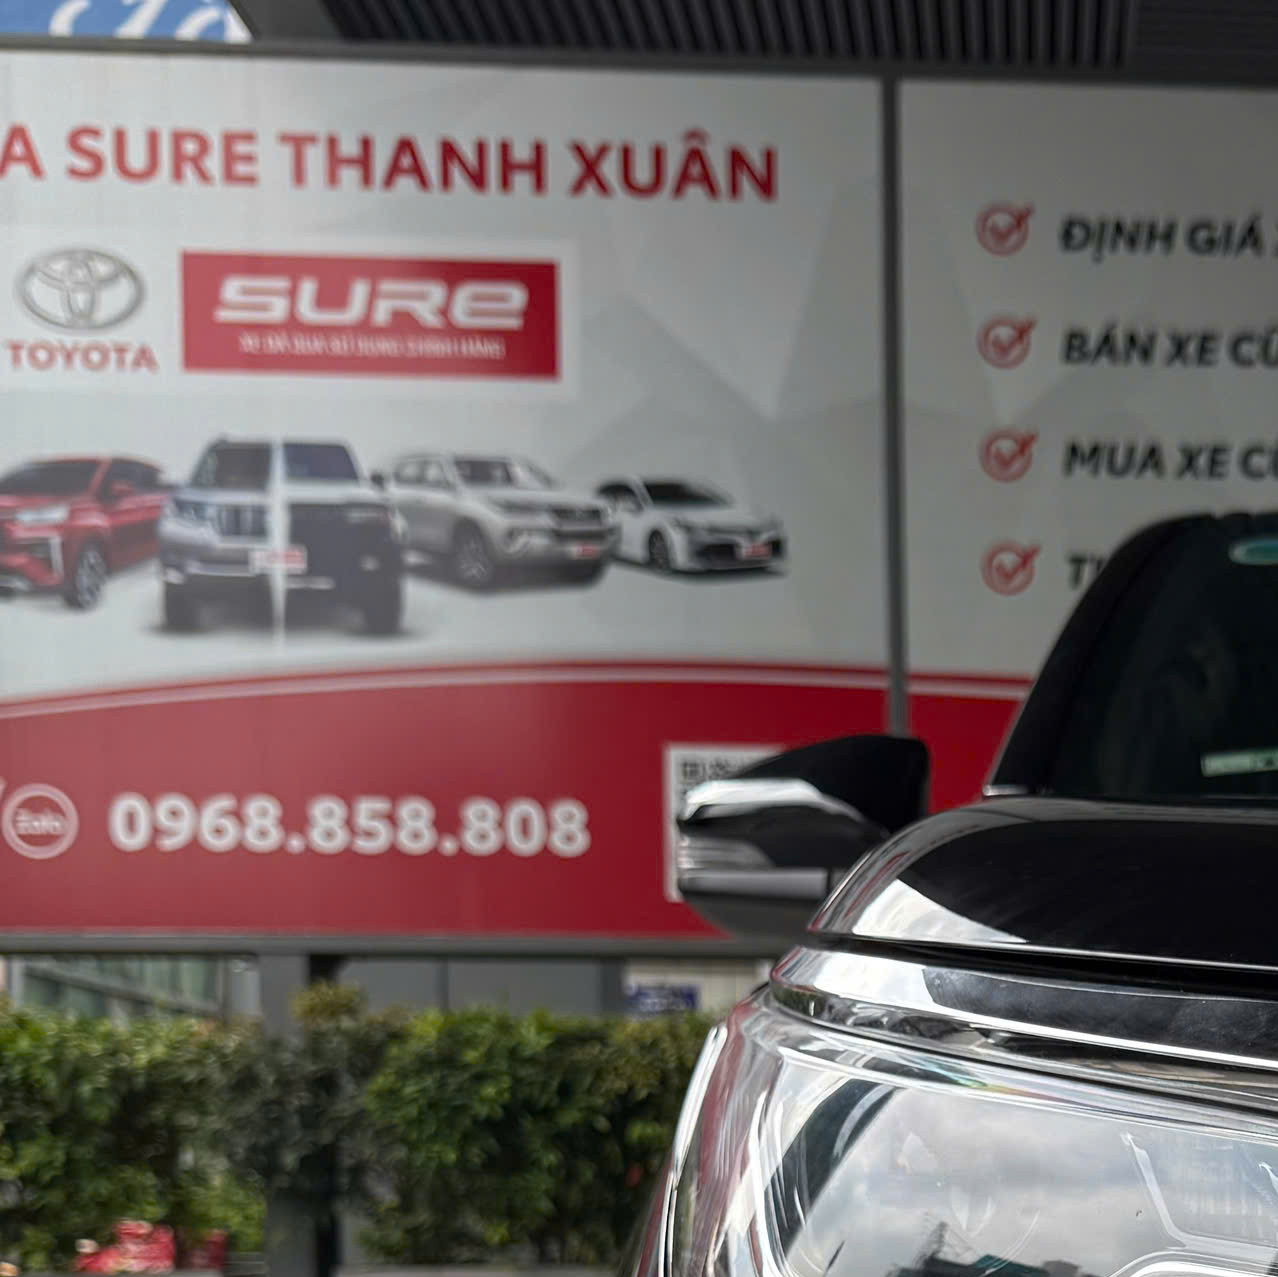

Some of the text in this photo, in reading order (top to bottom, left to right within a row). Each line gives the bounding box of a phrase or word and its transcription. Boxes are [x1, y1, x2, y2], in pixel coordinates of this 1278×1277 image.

[67, 126, 258, 187] SURE
[280, 134, 547, 195] THANH
[569, 131, 777, 200] XUÂN
[1059, 215, 1178, 263] ĐỊNH
[1185, 212, 1264, 258] GIÁ
[6, 341, 159, 373] TOYOTA
[1062, 322, 1158, 367] BÁN
[1165, 329, 1220, 367] XE
[1063, 439, 1166, 480] MUA
[1176, 442, 1230, 480] XE
[108, 791, 590, 858] 0968.858.808
